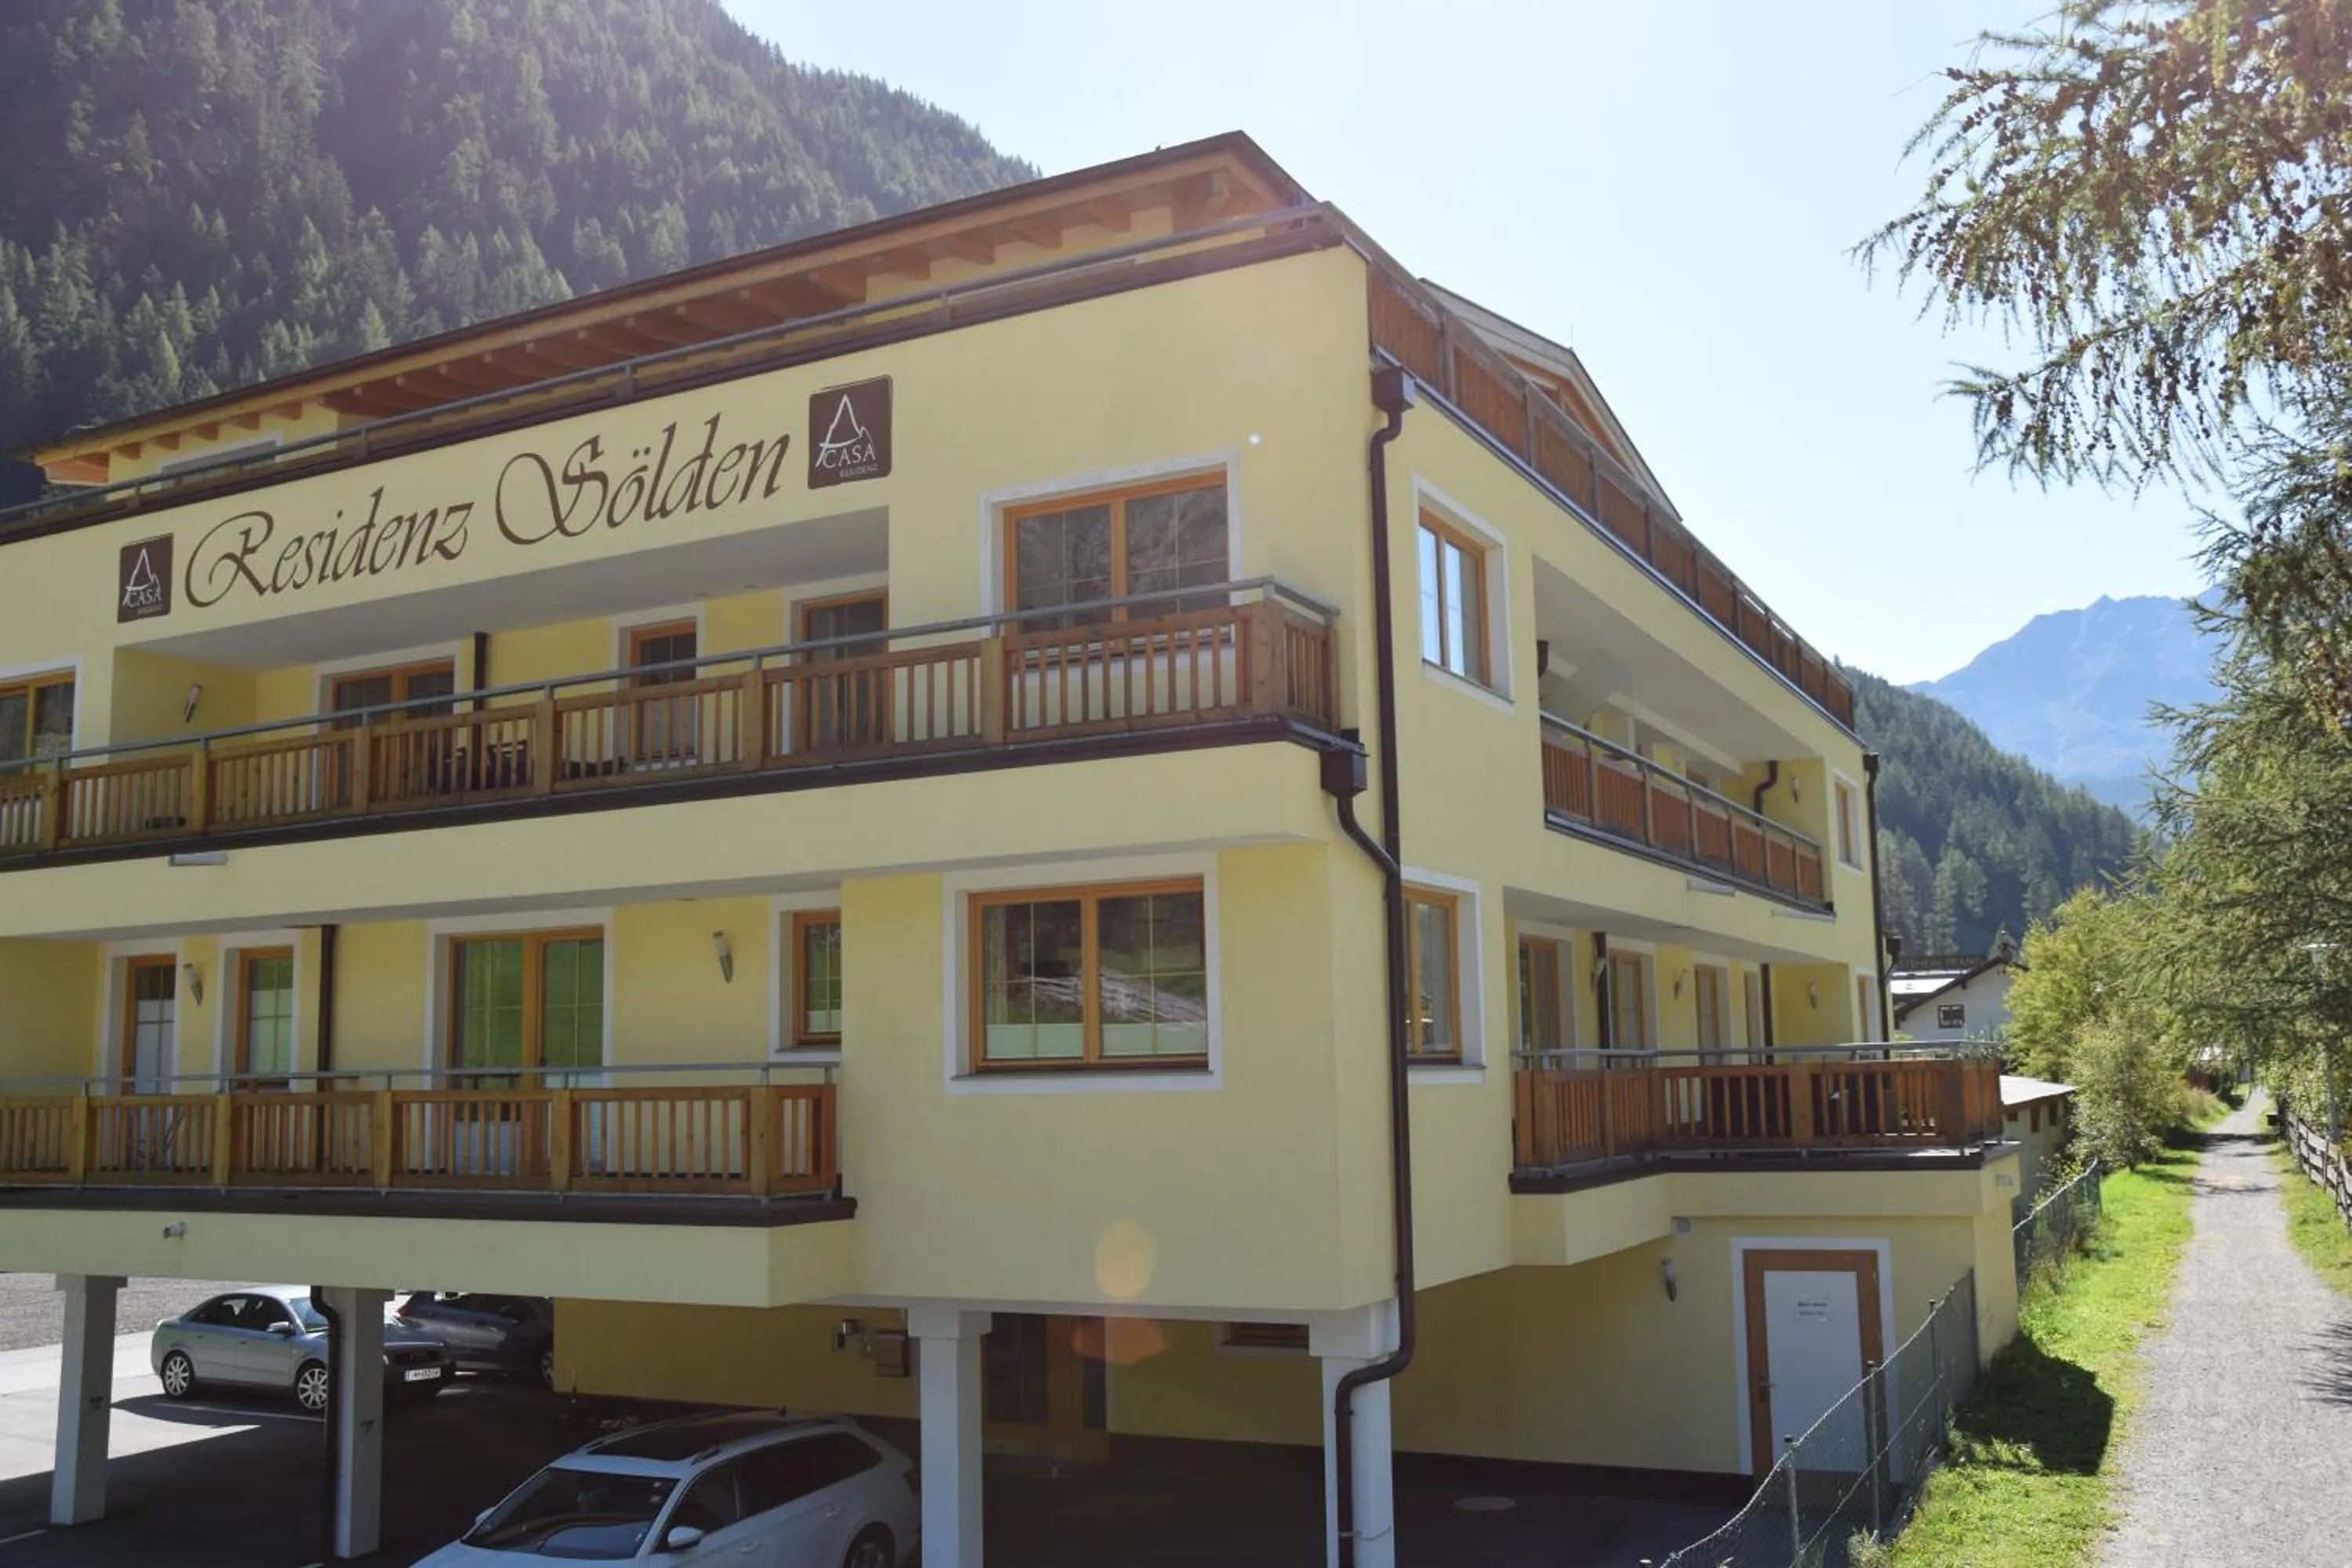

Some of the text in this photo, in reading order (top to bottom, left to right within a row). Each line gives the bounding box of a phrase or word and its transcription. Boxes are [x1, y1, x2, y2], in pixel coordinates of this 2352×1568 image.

[184, 412, 790, 608] Residenz Sölden
[822, 443, 876, 469] CASA
